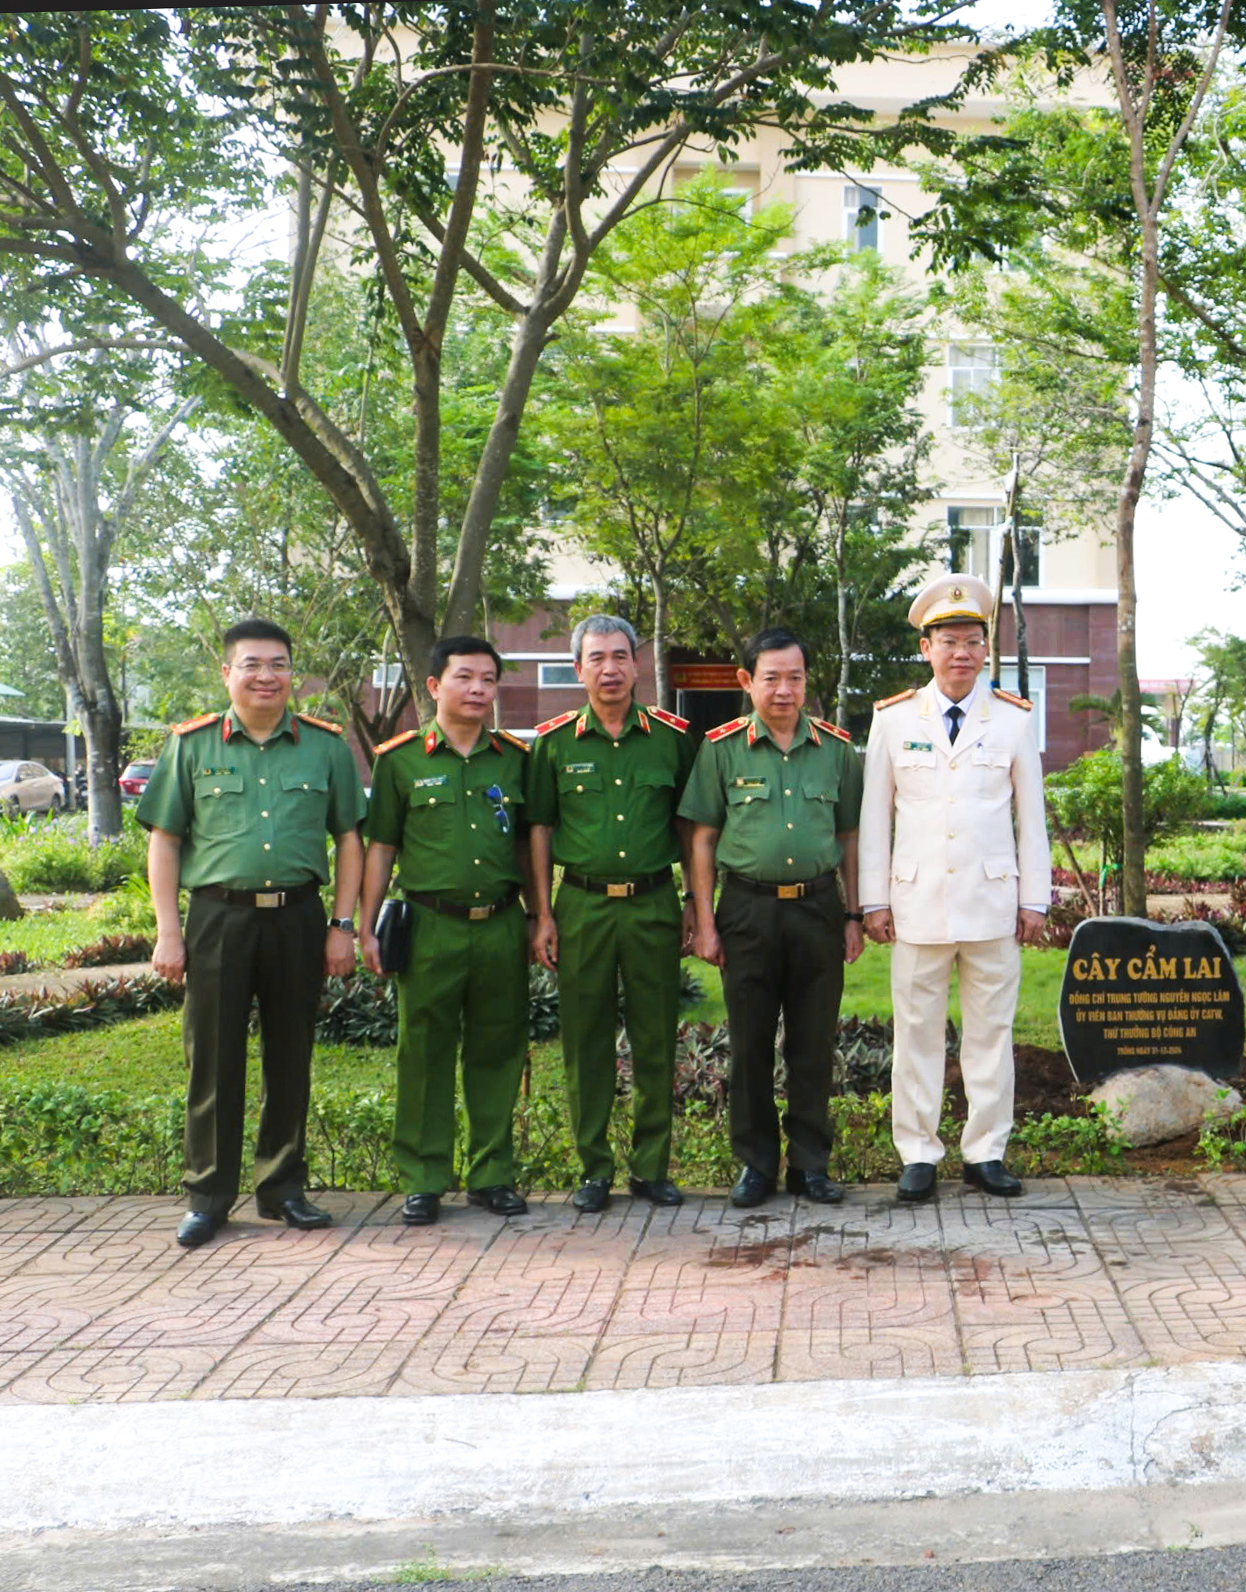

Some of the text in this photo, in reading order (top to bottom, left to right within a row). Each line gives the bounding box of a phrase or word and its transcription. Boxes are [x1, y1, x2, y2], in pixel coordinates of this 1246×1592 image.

[1073, 944, 1221, 980] CÂY CẨM LAI
[1092, 991, 1105, 1004] CHÍ
[1107, 993, 1131, 1003] TRUNG
[1107, 1011, 1123, 1021] BAN
[1186, 1028, 1196, 1037] AN
